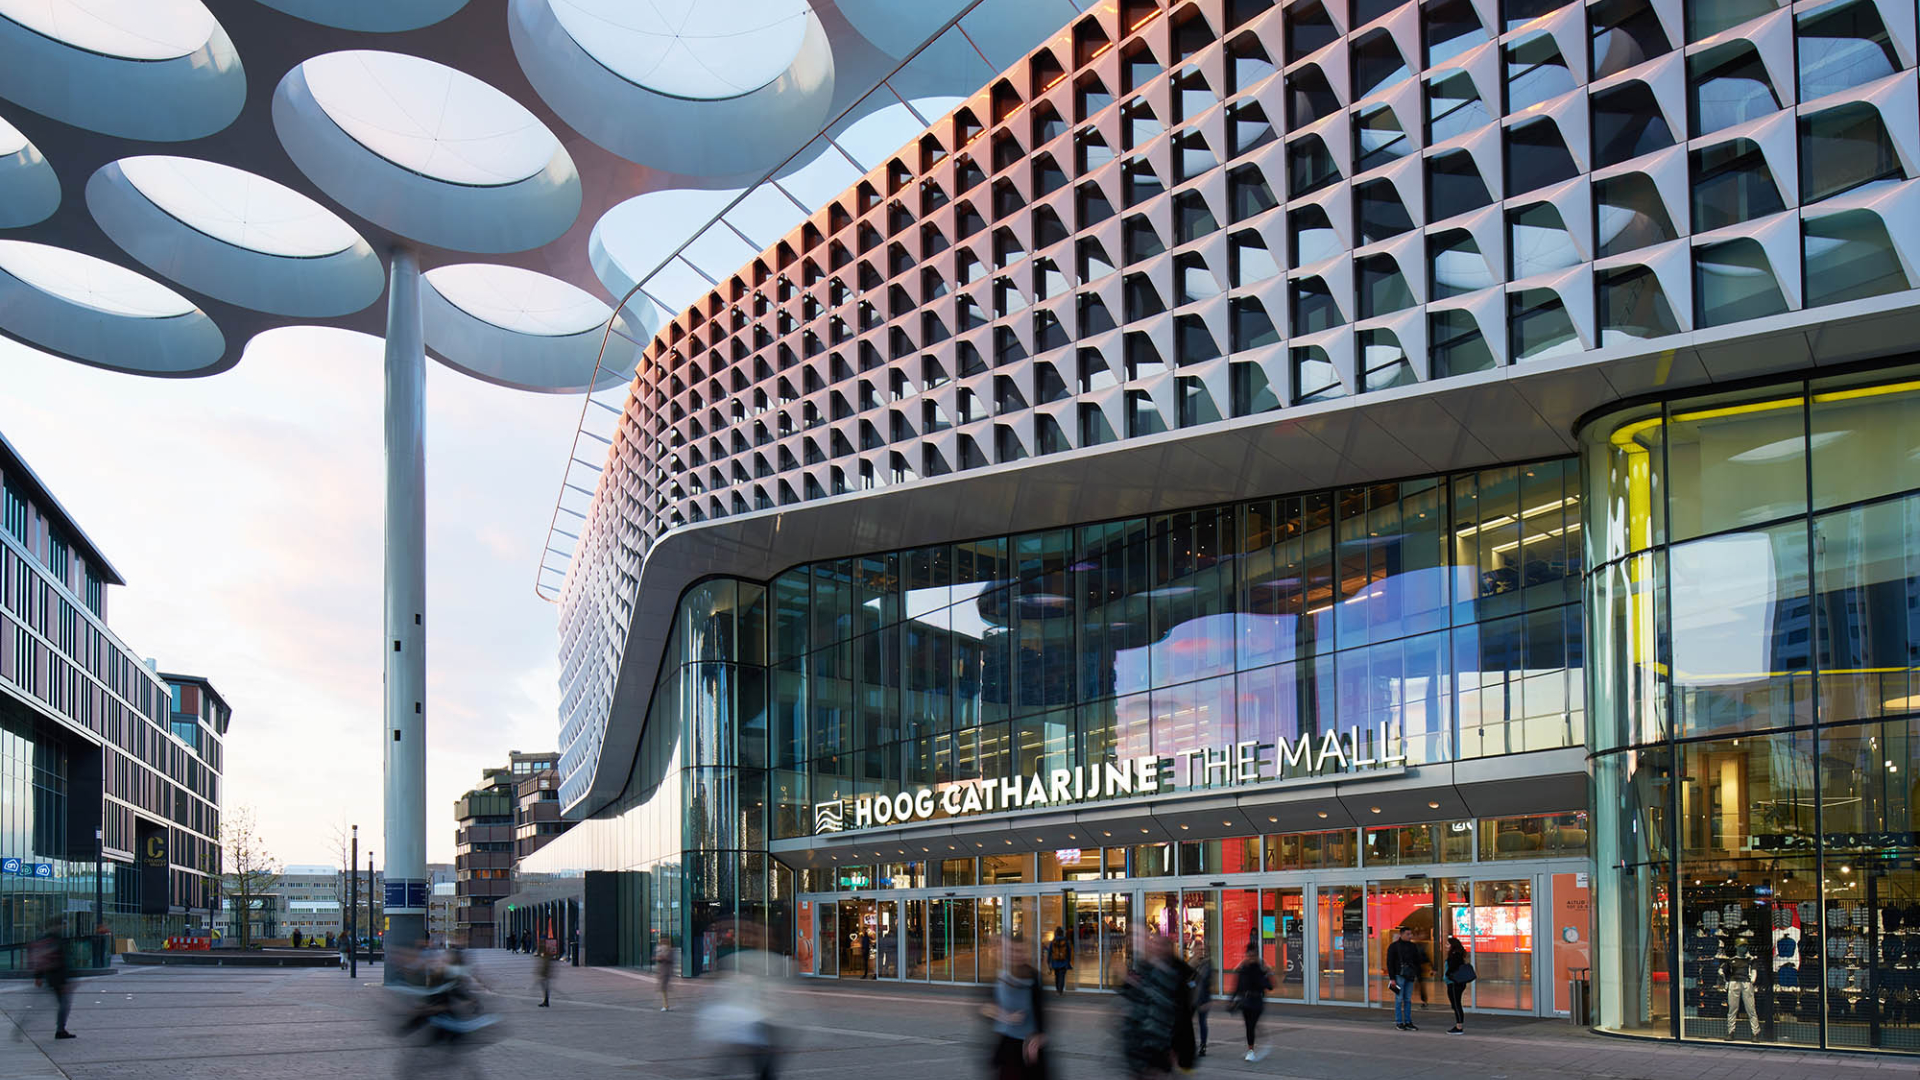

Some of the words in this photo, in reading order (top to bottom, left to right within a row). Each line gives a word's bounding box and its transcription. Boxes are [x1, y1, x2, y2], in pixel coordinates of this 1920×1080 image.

[856, 788, 936, 827] HOOG
[943, 754, 1160, 815] CATHARIJNE
[1175, 740, 1260, 787] THE
[1276, 720, 1407, 776] MALL
